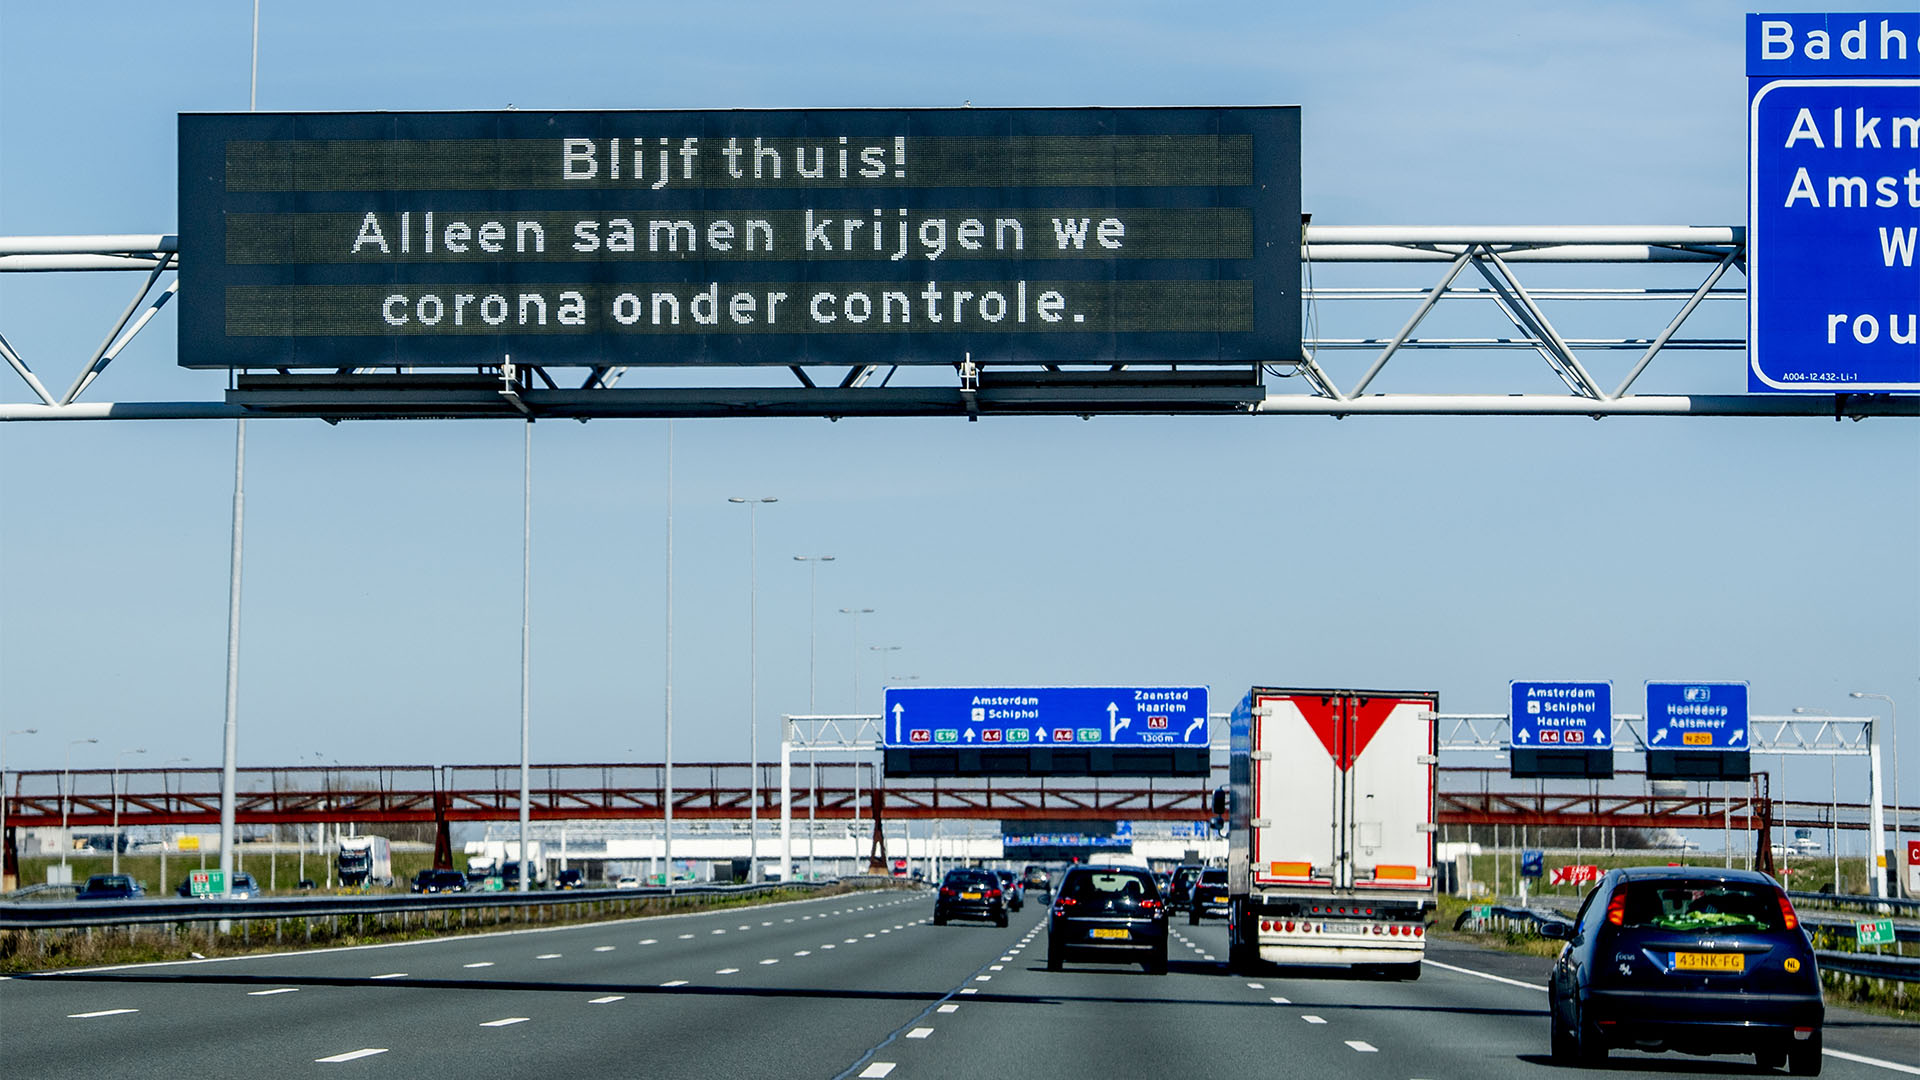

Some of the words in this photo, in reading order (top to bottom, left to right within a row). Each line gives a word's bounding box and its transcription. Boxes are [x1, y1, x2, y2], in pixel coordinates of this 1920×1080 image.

[1784, 106, 1920, 149] Alkm
[563, 138, 698, 190] Blijf
[722, 137, 906, 179] thuis!
[1784, 167, 1920, 208] Amst
[351, 211, 545, 254] Alleen
[572, 218, 773, 256] samen
[805, 208, 1025, 260] krijgen
[1051, 217, 1125, 249] we
[1879, 227, 1918, 267] W
[382, 291, 586, 326] corona
[612, 281, 788, 325] onder
[810, 280, 1085, 323] controle.
[1827, 313, 1917, 345] rou
[1134, 690, 1189, 701] Zaanstad
[1527, 687, 1596, 699] Amsterdam
[971, 696, 1039, 706] Amsterdam
[1137, 703, 1186, 713] Haarlem
[1544, 702, 1596, 713] Schiphol
[1667, 704, 1728, 716] Hoofddorp
[988, 709, 1039, 720] Schiphol
[1537, 716, 1587, 727] Haarlem
[1669, 718, 1726, 730] Aalsmeer
[1679, 955, 1740, 968] 43-NK-FG
[1787, 961, 1796, 969] NL
